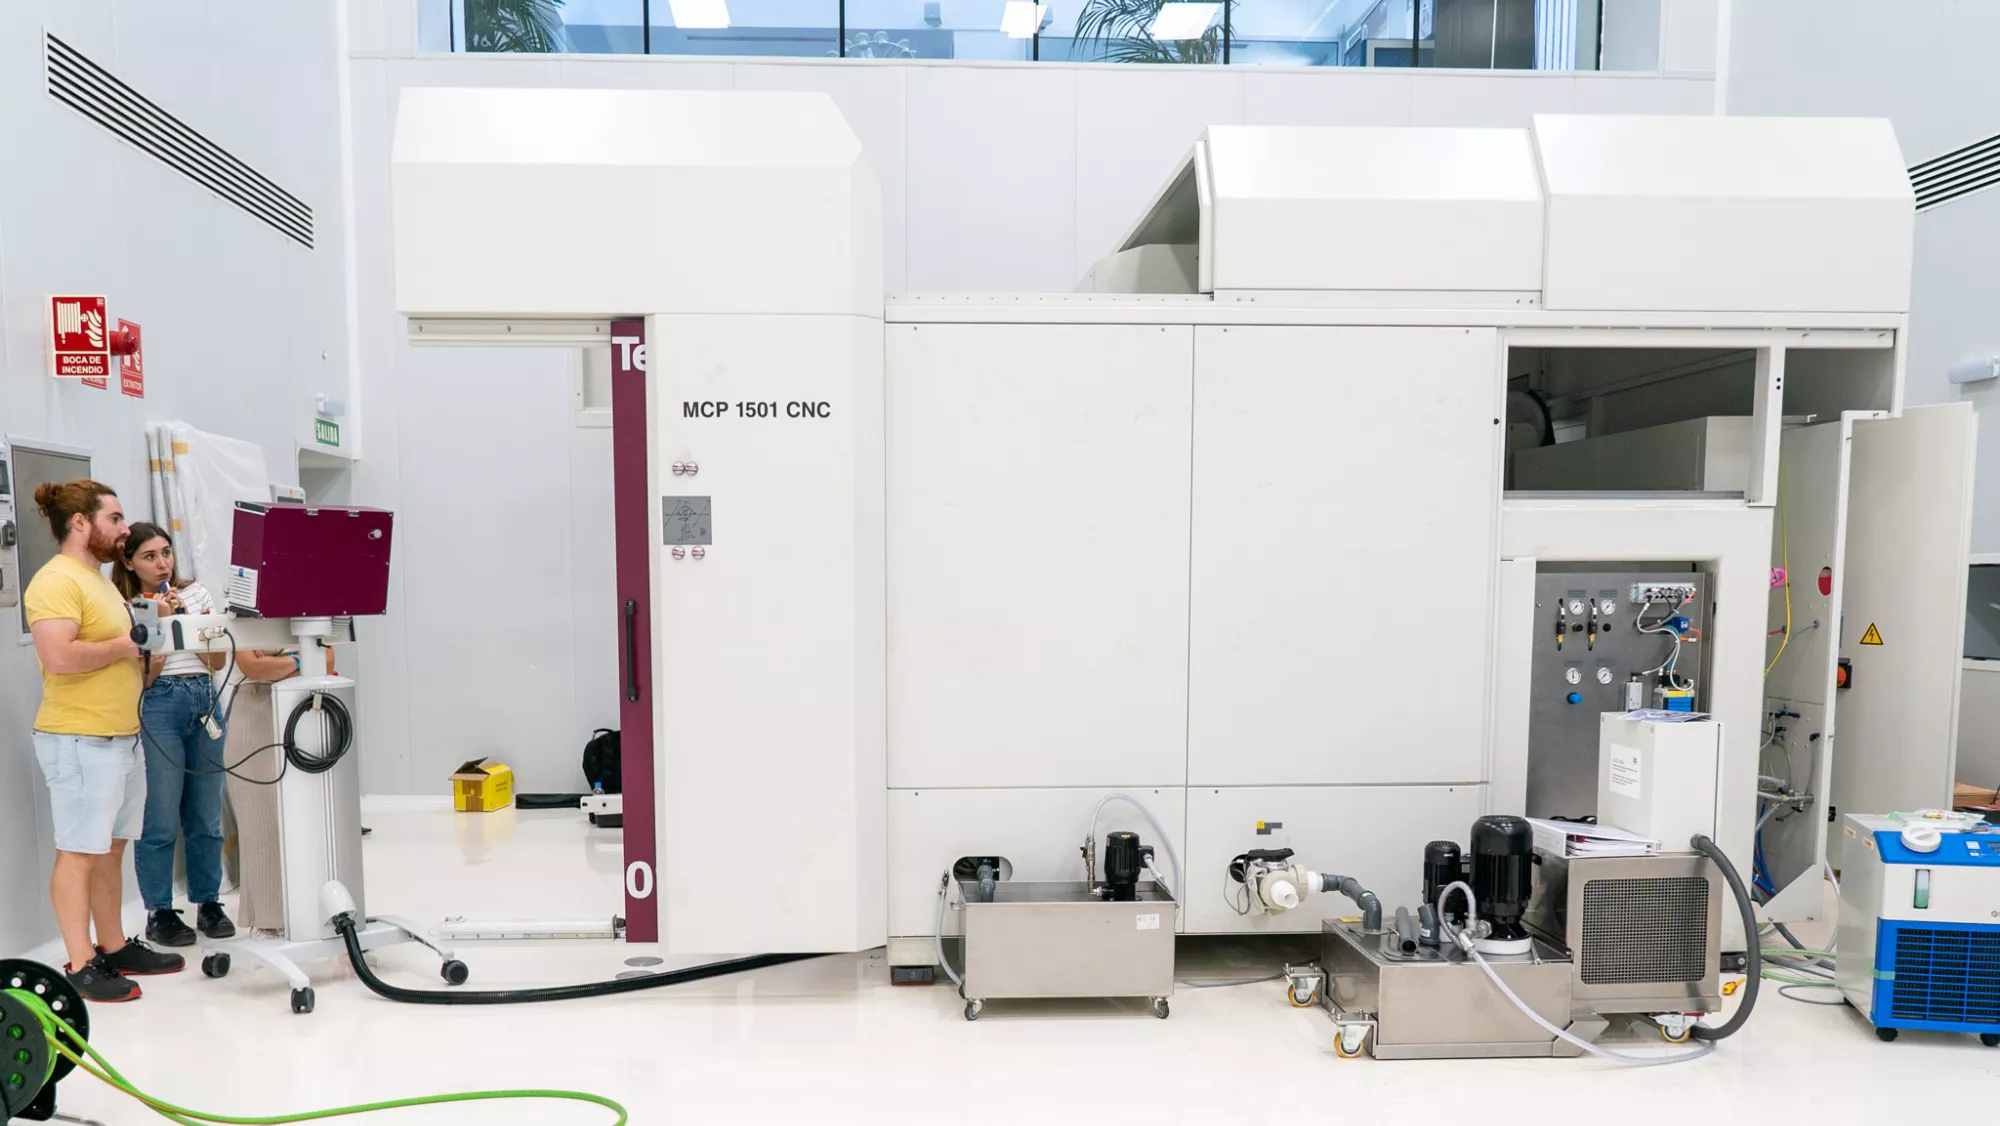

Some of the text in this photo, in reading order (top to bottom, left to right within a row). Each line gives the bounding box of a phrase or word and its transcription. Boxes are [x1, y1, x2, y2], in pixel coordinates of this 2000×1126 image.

[63, 356, 101, 364] BOCA DE
[62, 366, 103, 374] INCENDIO
[683, 402, 831, 417] MCP 1501 CNC
[317, 422, 338, 443] SALIDA
